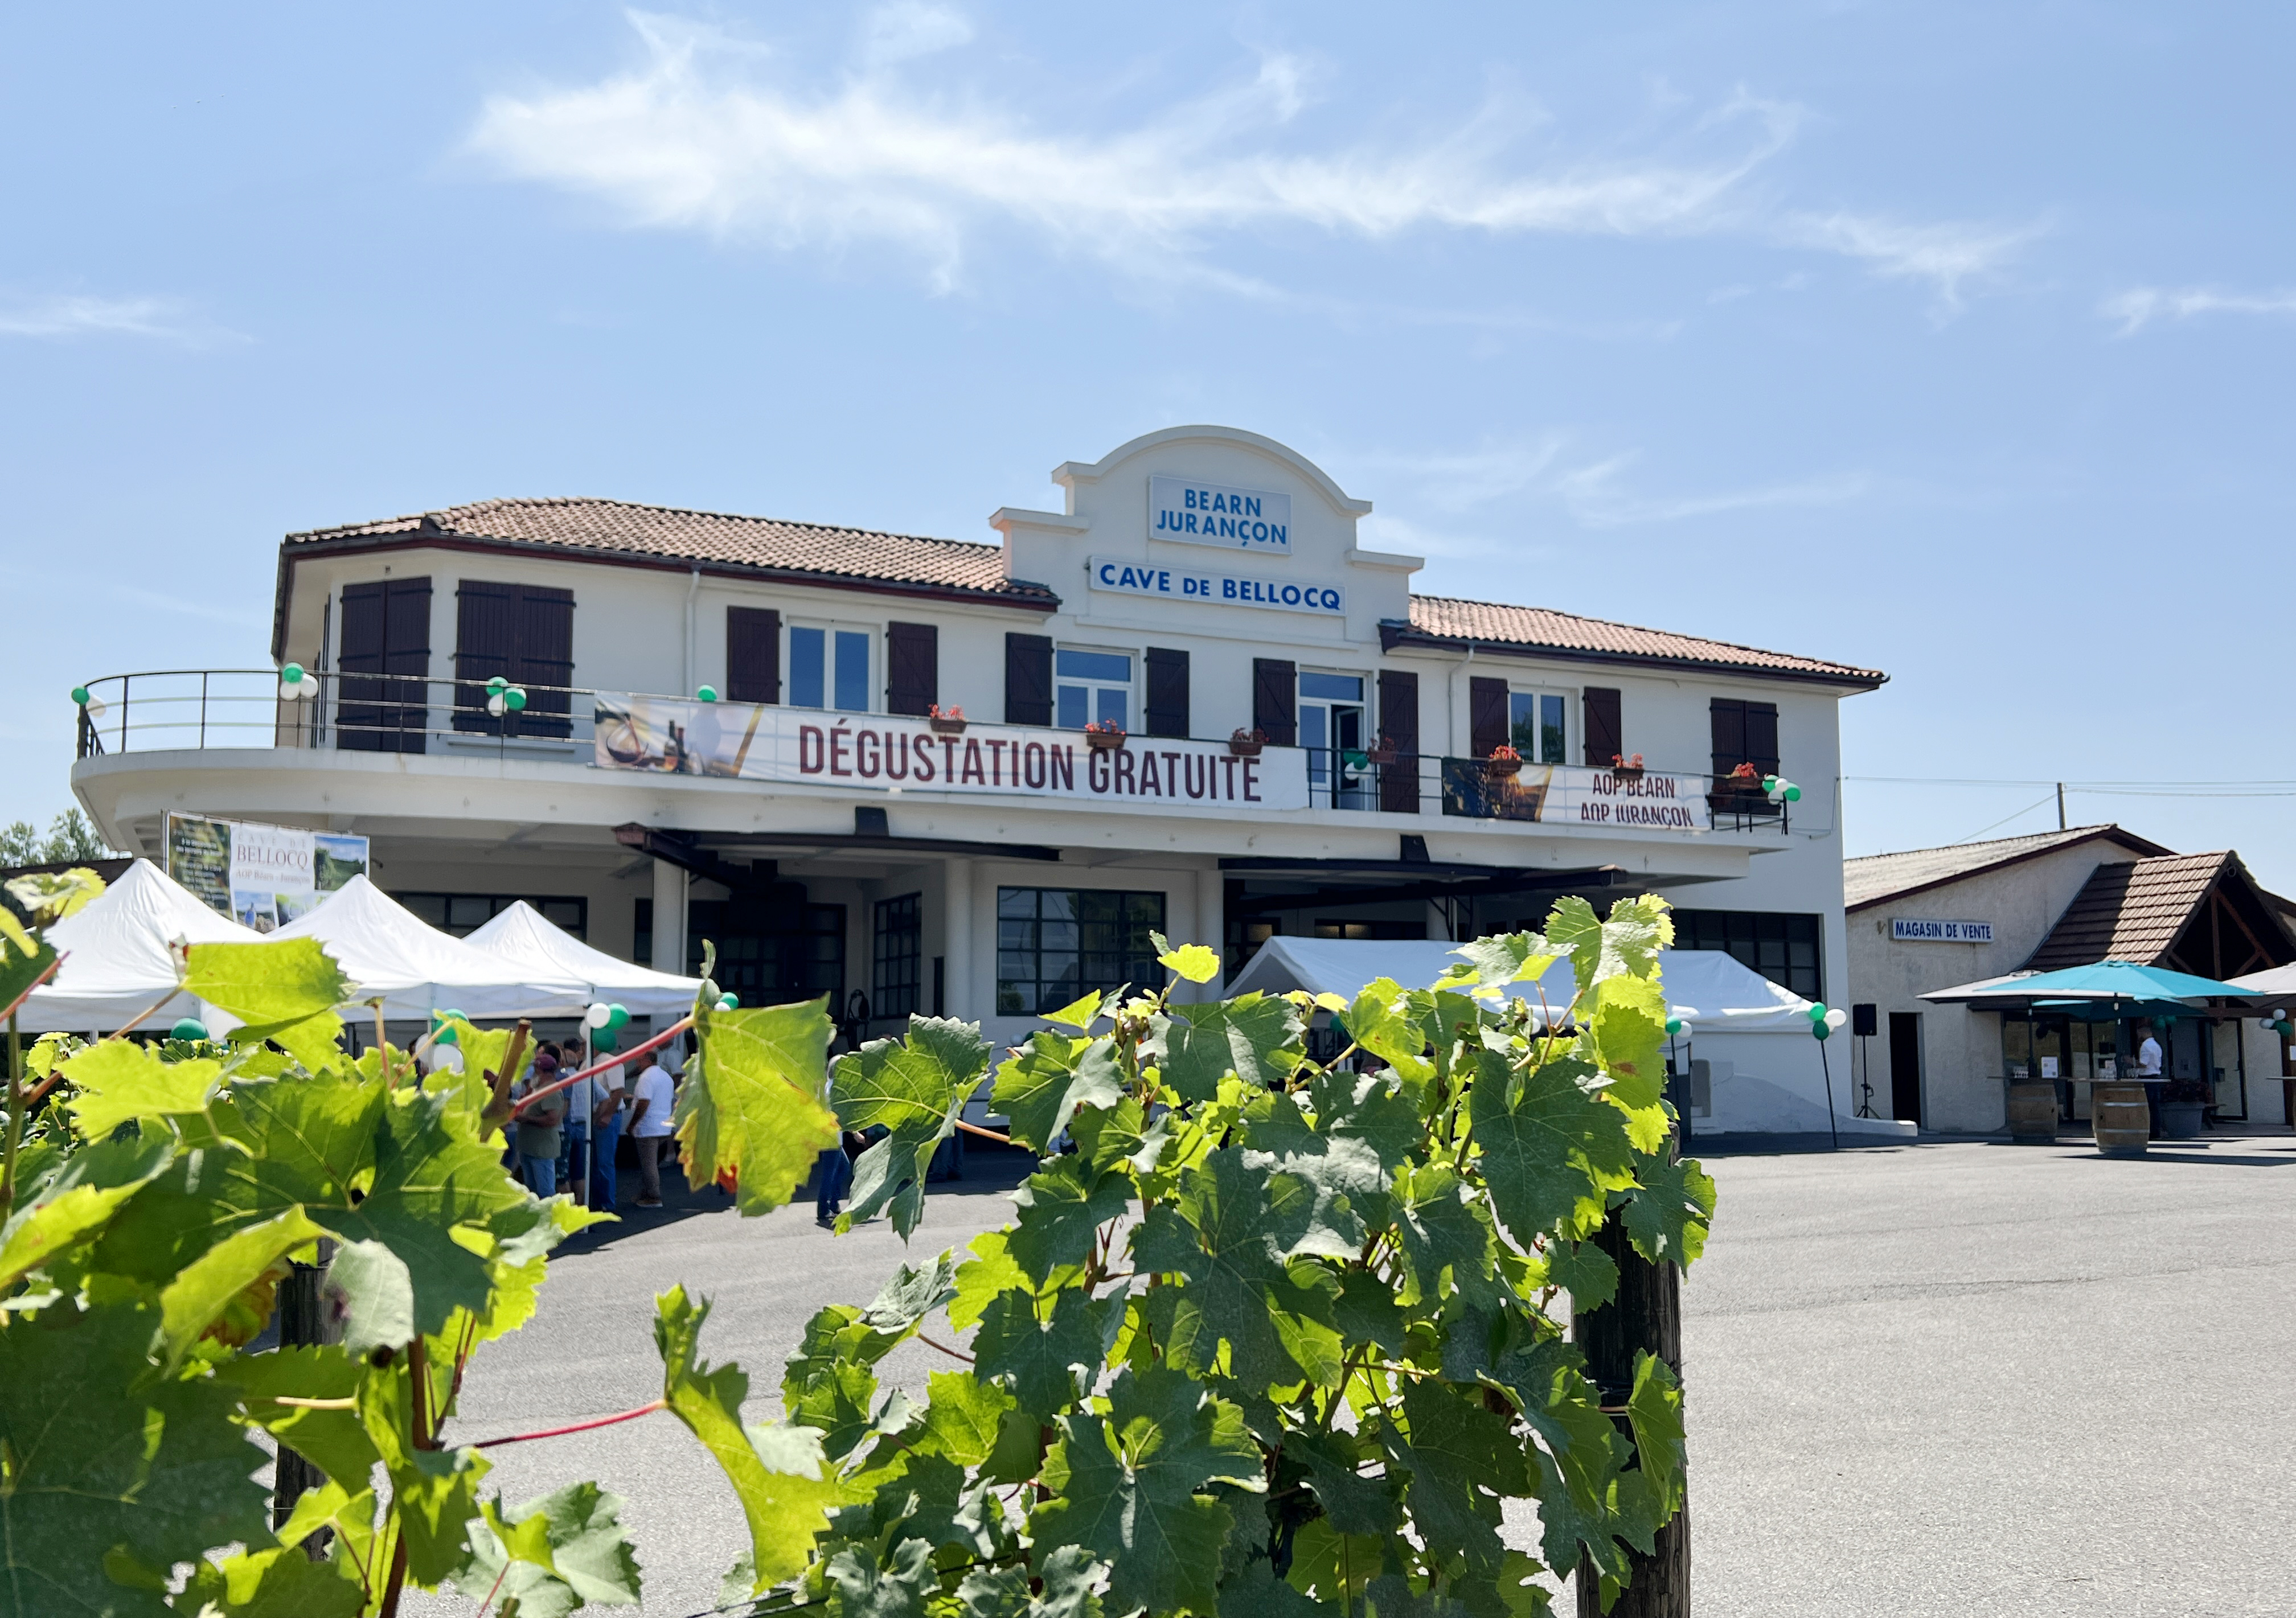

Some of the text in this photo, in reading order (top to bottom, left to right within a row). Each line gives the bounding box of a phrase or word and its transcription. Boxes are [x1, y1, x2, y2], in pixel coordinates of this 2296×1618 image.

[1185, 488, 1261, 518] BEARN
[1157, 510, 1286, 547] JURANÇON
[1100, 564, 1340, 610] CAVE DE BELLOCQ
[800, 718, 1261, 802] DÉGUSTATION GRATUITE
[1593, 773, 1622, 795] AOP
[237, 844, 308, 872] BELLOCQ
[1896, 921, 1991, 939] MAGASIN DE VENTE
